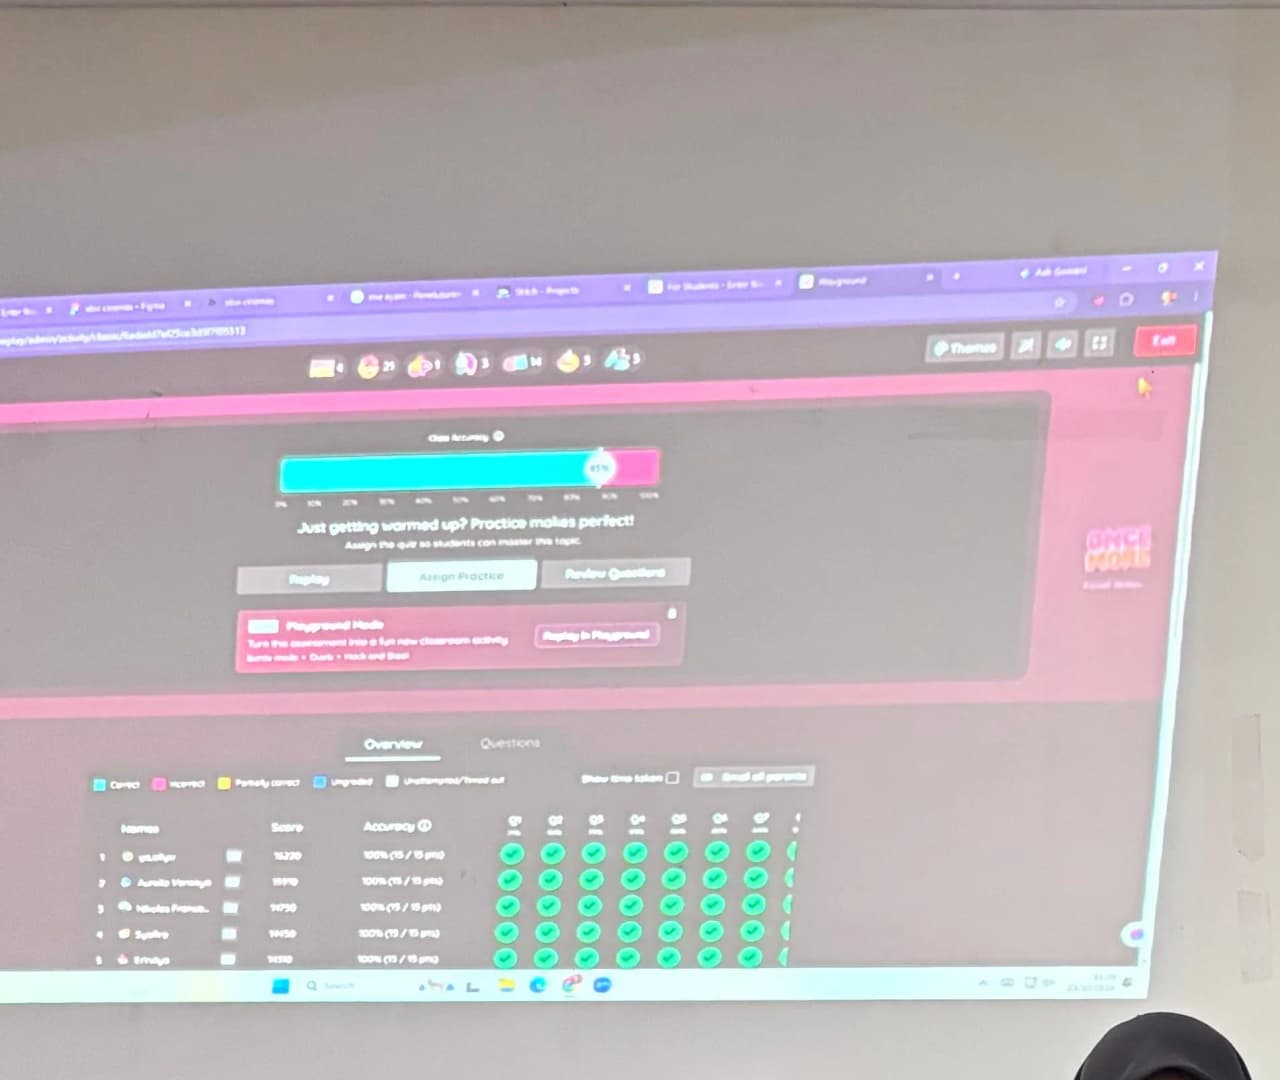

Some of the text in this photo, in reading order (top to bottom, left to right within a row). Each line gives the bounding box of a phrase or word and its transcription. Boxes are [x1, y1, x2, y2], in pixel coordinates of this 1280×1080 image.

[297, 514, 635, 536] Just getting warmed up? Practice makes perfect!
[345, 541, 377, 552] Assign
[433, 538, 475, 548] students
[419, 571, 504, 583] Assign Practice
[608, 567, 666, 581] Questions
[363, 738, 423, 750] Overview
[480, 738, 540, 750] Questions
[363, 821, 416, 833] Accuracy
